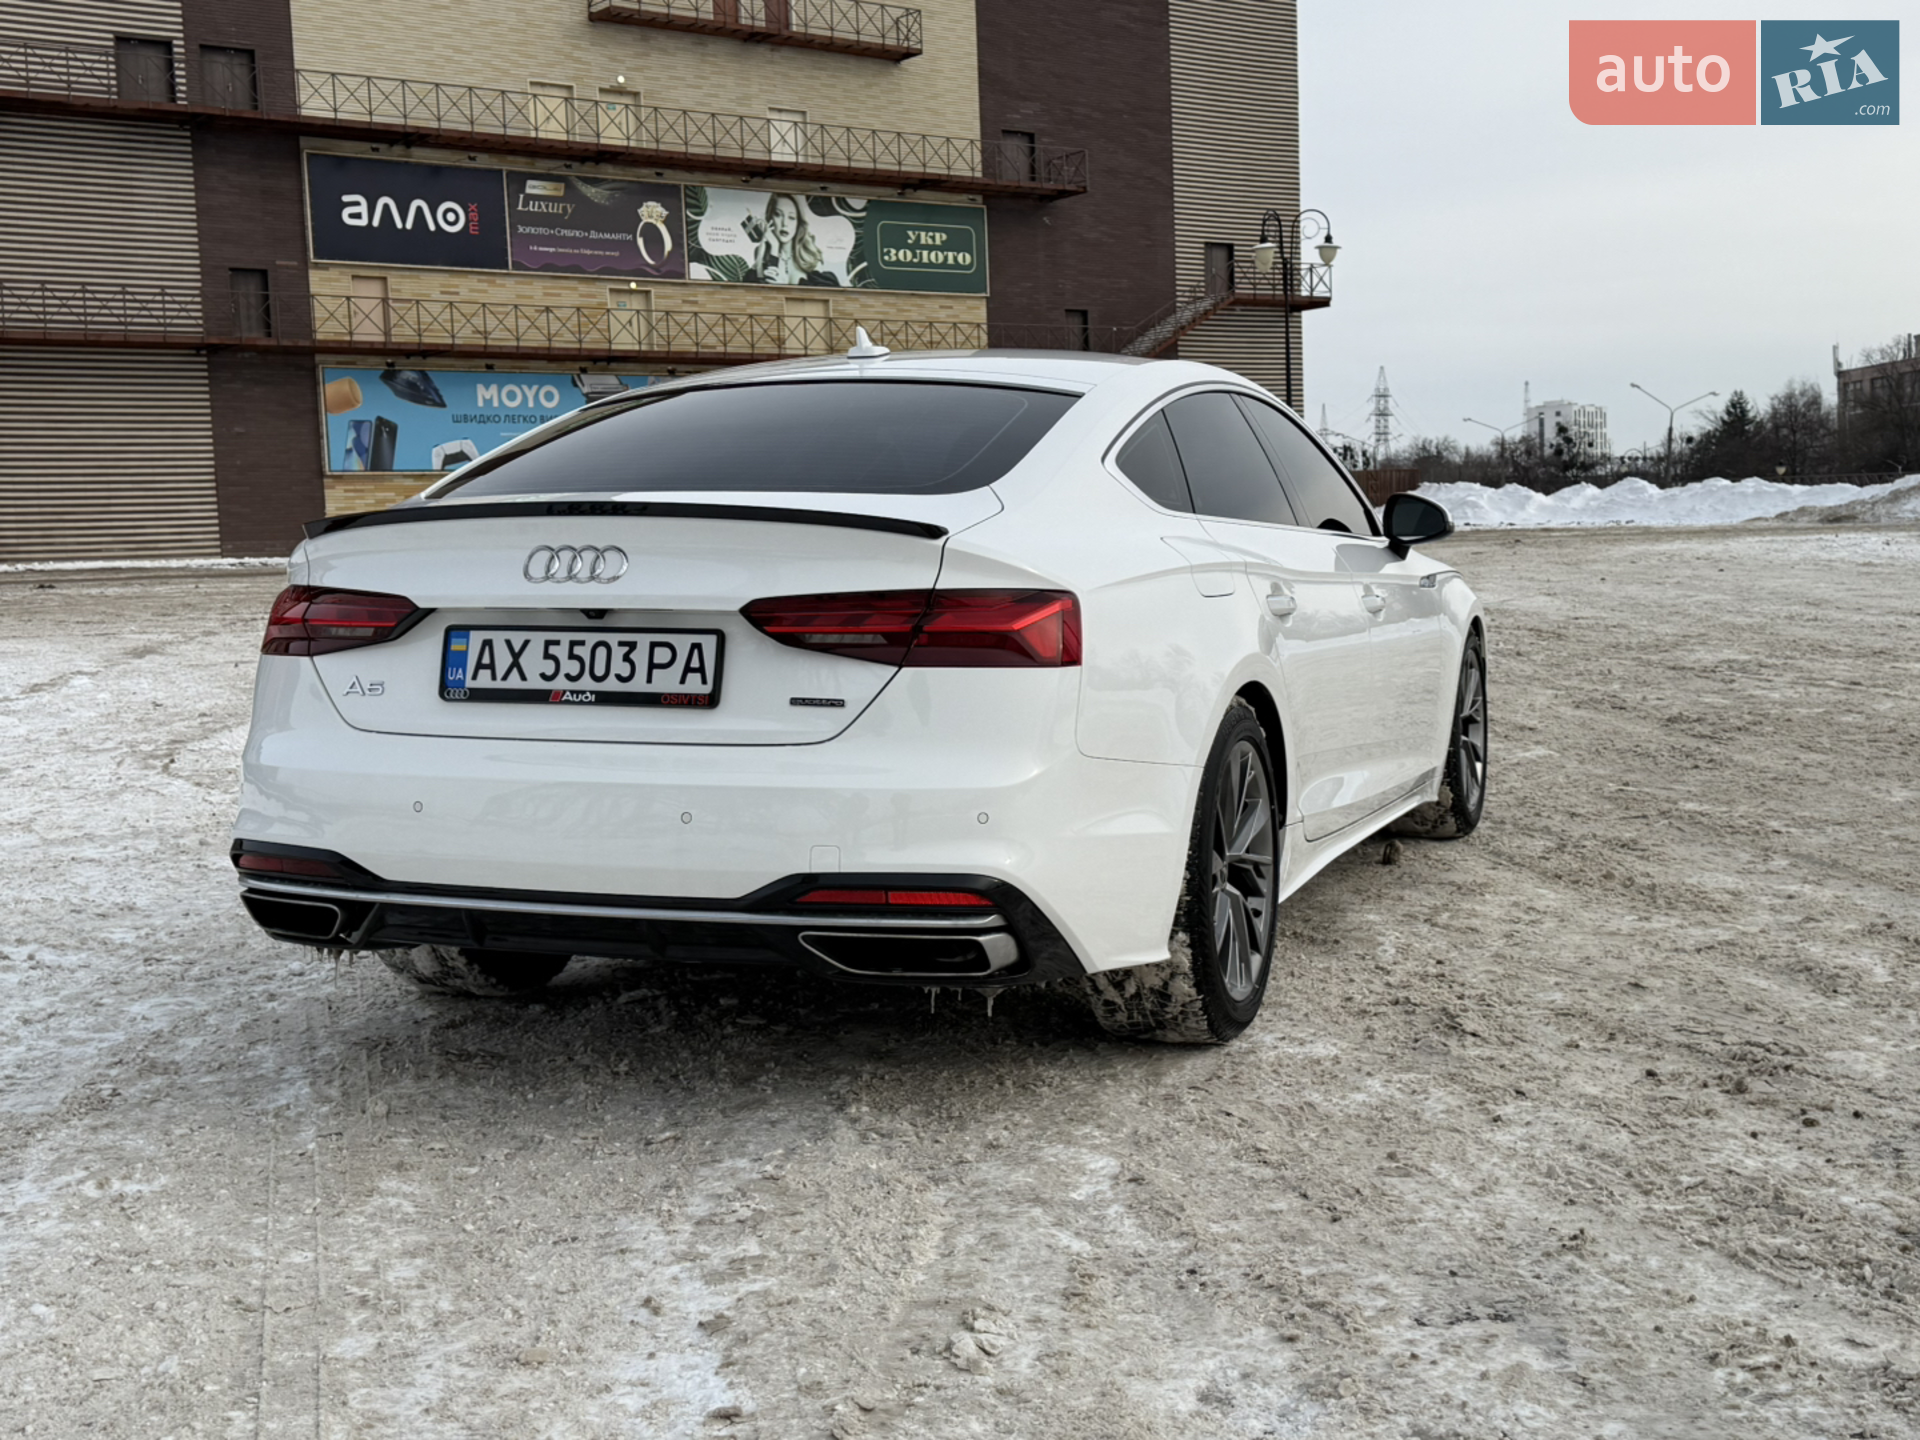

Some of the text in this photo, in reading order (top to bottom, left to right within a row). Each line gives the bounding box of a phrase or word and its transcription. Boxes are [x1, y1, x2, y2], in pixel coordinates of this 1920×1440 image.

[516, 194, 576, 219] Luxury
[468, 203, 479, 234] max
[906, 230, 948, 245] УКР
[883, 247, 972, 265] ЗОЛОТО
[476, 383, 560, 408] MOYO
[452, 414, 501, 424] ШВИДКО
[503, 414, 538, 425] ЛЕГКО
[471, 638, 709, 685] AX 5503 PA
[447, 667, 464, 680] UA
[342, 675, 385, 697] A5
[561, 690, 596, 702] Audi
